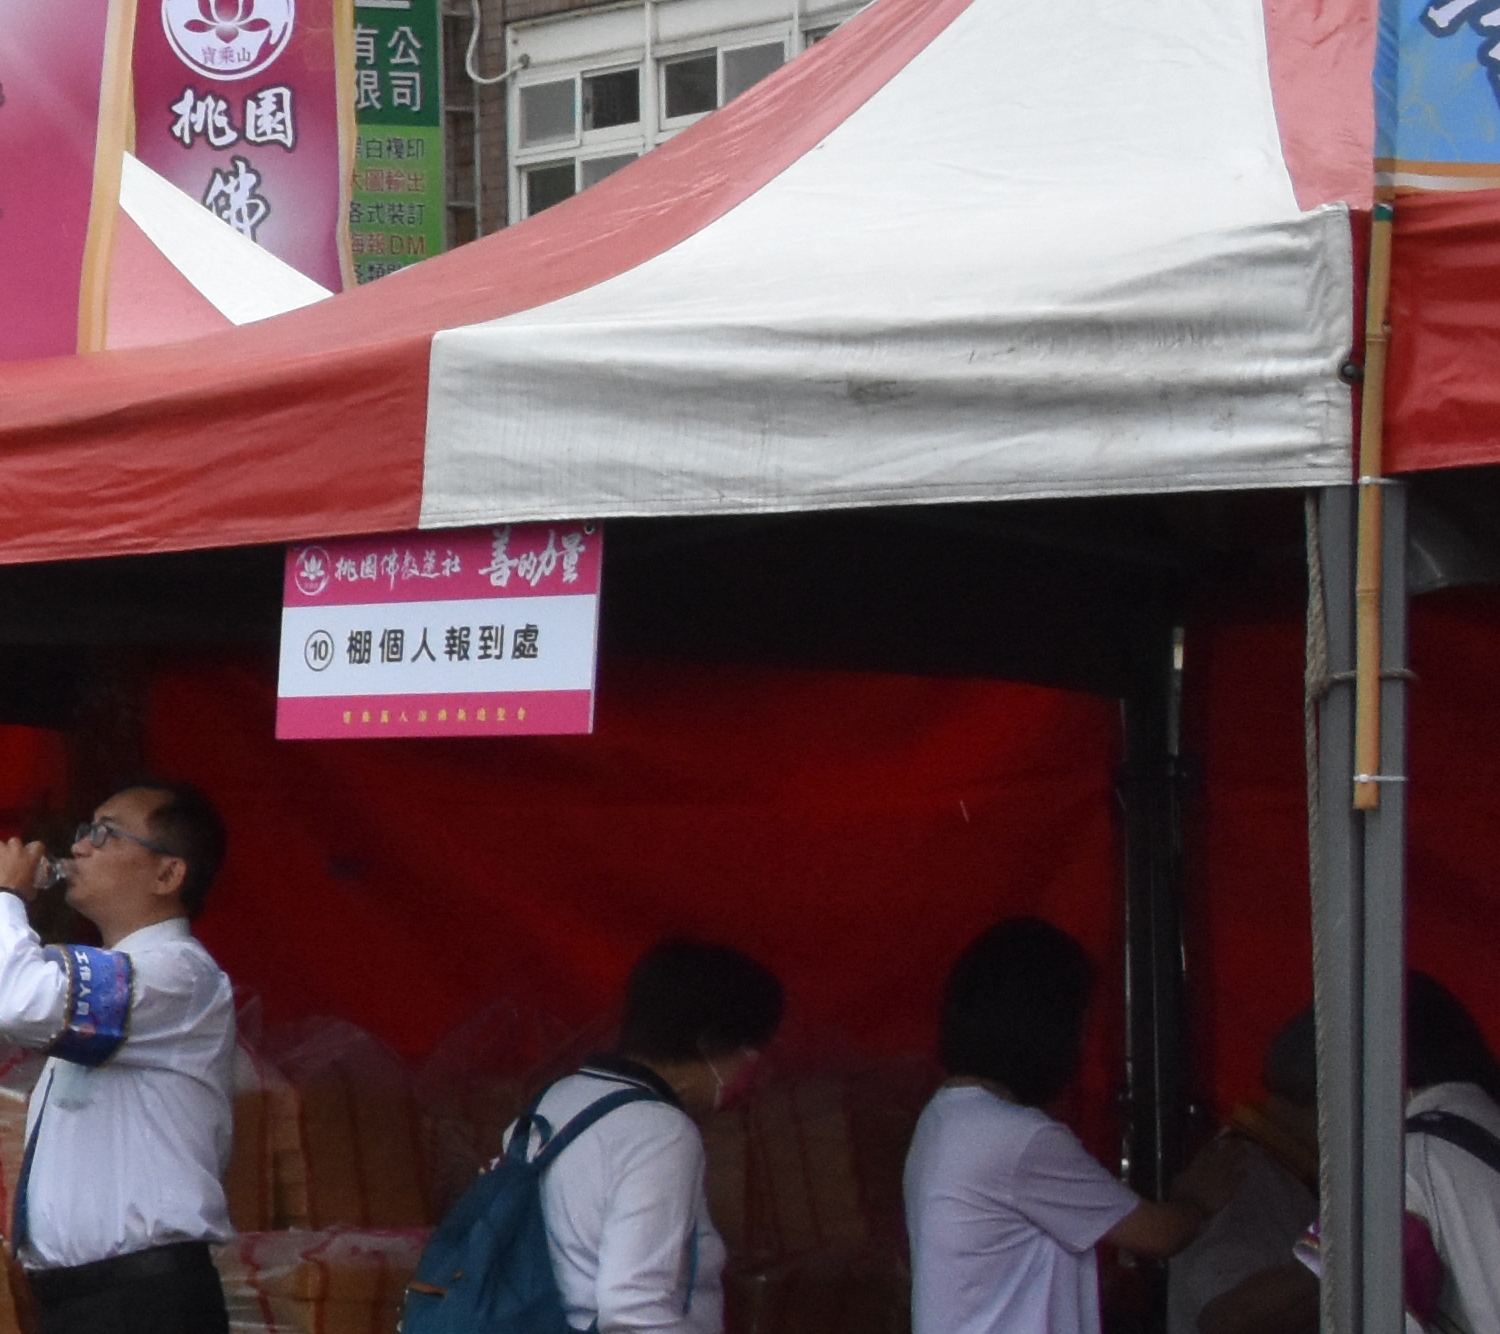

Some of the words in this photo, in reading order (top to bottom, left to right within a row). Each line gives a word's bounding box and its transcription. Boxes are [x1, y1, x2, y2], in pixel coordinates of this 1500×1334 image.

[346, 623, 540, 665] 棚個人報到處
